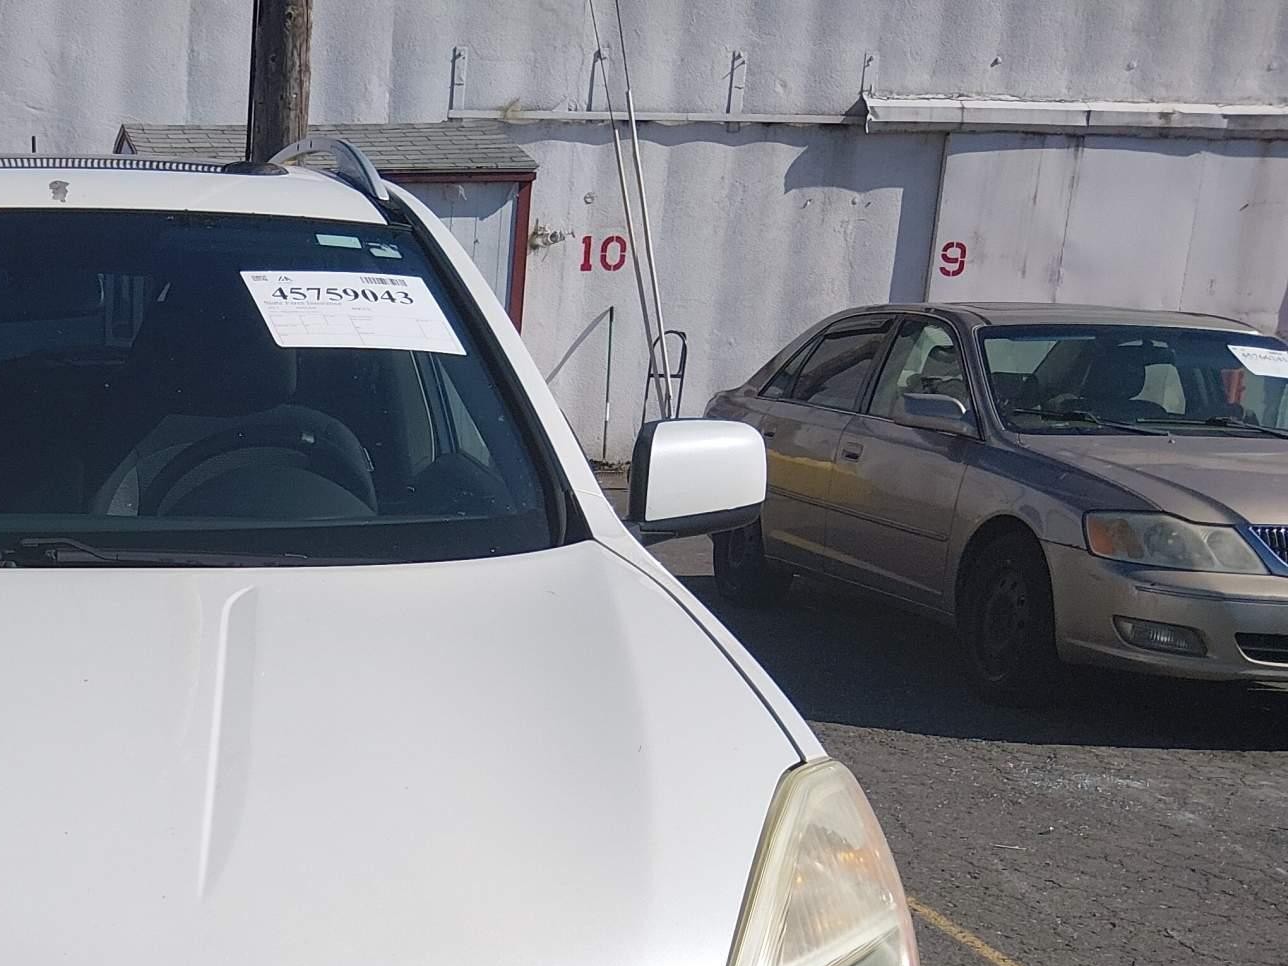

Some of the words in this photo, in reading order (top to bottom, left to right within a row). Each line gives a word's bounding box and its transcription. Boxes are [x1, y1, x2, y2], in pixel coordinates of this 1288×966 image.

[580, 235, 627, 272] 10
[939, 241, 967, 277] 9
[271, 286, 415, 305] 45759043
